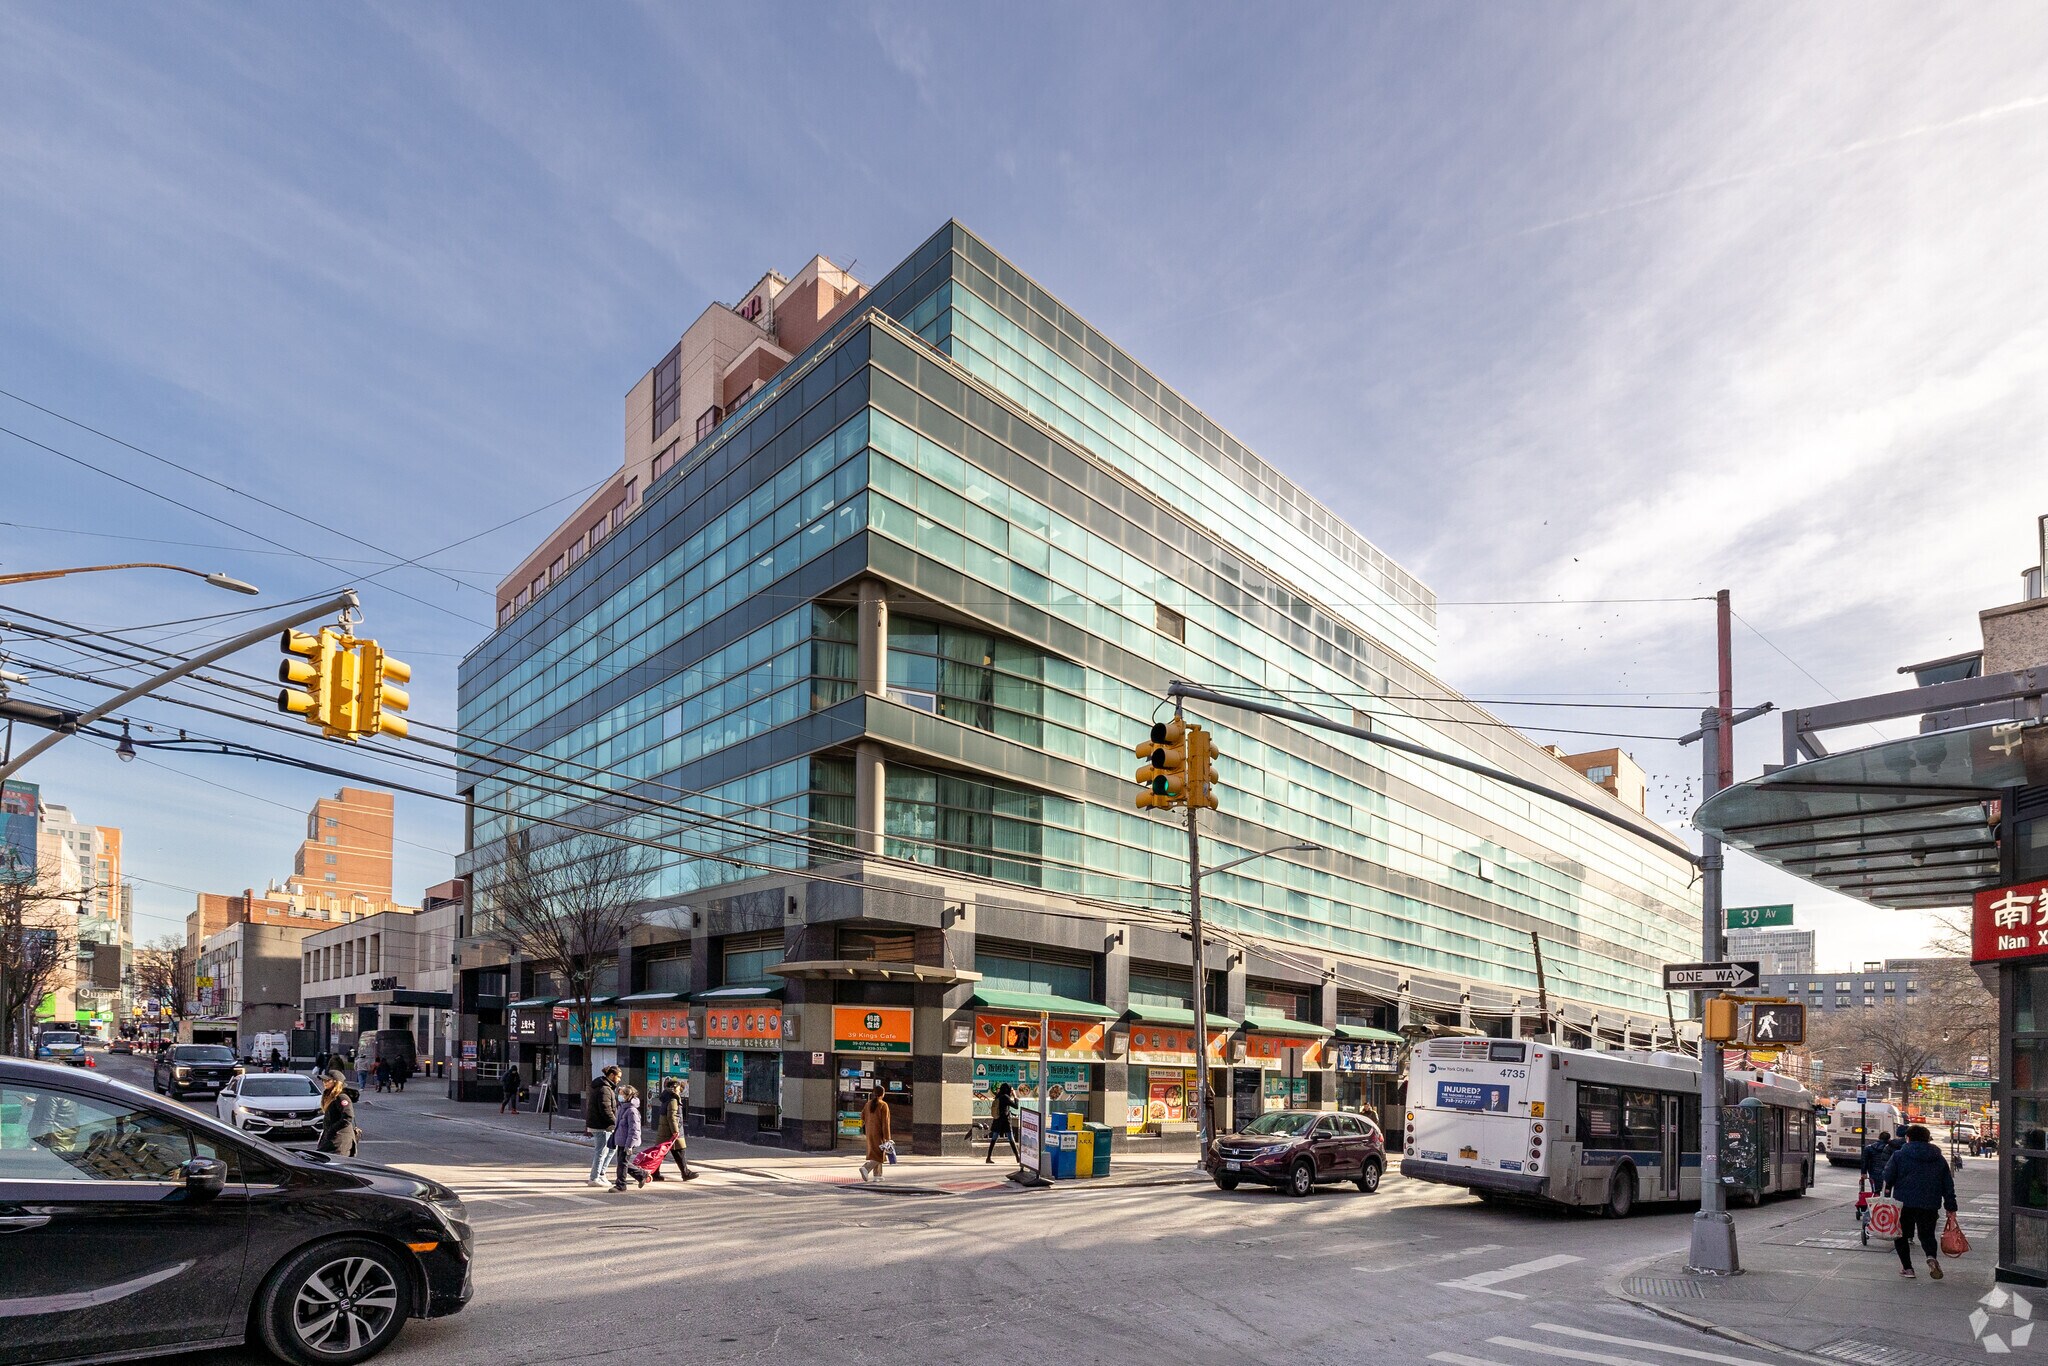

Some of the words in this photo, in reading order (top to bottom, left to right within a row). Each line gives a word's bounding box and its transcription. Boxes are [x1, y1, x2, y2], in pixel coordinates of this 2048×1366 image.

[1741, 909, 1759, 926] 39
[1765, 908, 1777, 919] Av
[1998, 935, 2027, 951] Nan
[1676, 971, 1703, 982] ONE
[1715, 969, 1745, 981] WAY
[510, 1009, 518, 1034] ARK
[1499, 1068, 1526, 1079] 4735
[1443, 1085, 1481, 1095] INJURED?
